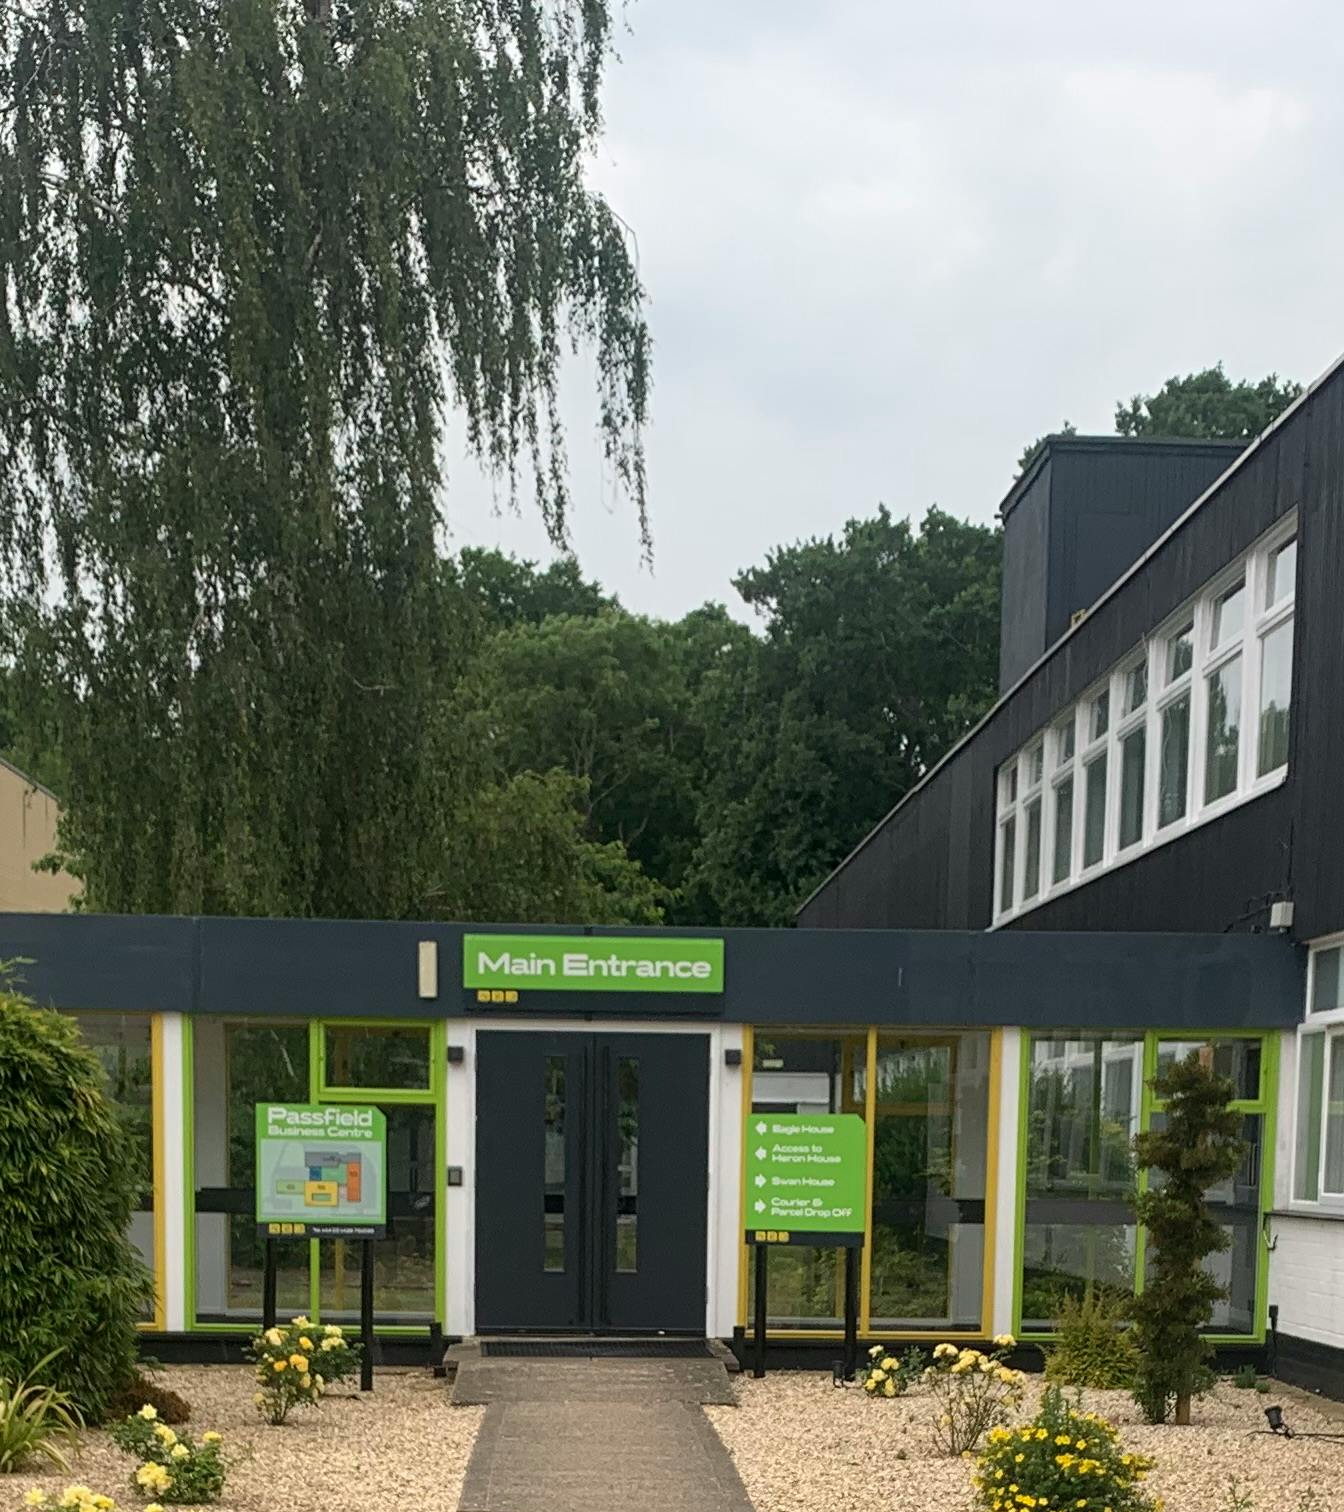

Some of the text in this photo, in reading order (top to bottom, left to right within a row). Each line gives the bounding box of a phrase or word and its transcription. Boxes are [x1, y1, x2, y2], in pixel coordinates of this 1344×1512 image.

[478, 952, 711, 978] Main Entrance
[267, 1107, 372, 1126] Passfield
[267, 1125, 373, 1137] Business Centre
[772, 1124, 834, 1135] Eagle House
[772, 1144, 822, 1153] Access to
[772, 1154, 841, 1163] Heron House
[771, 1177, 835, 1186] Swan House
[771, 1197, 810, 1206] Courier
[771, 1207, 853, 1218] Parcel Drop Off
